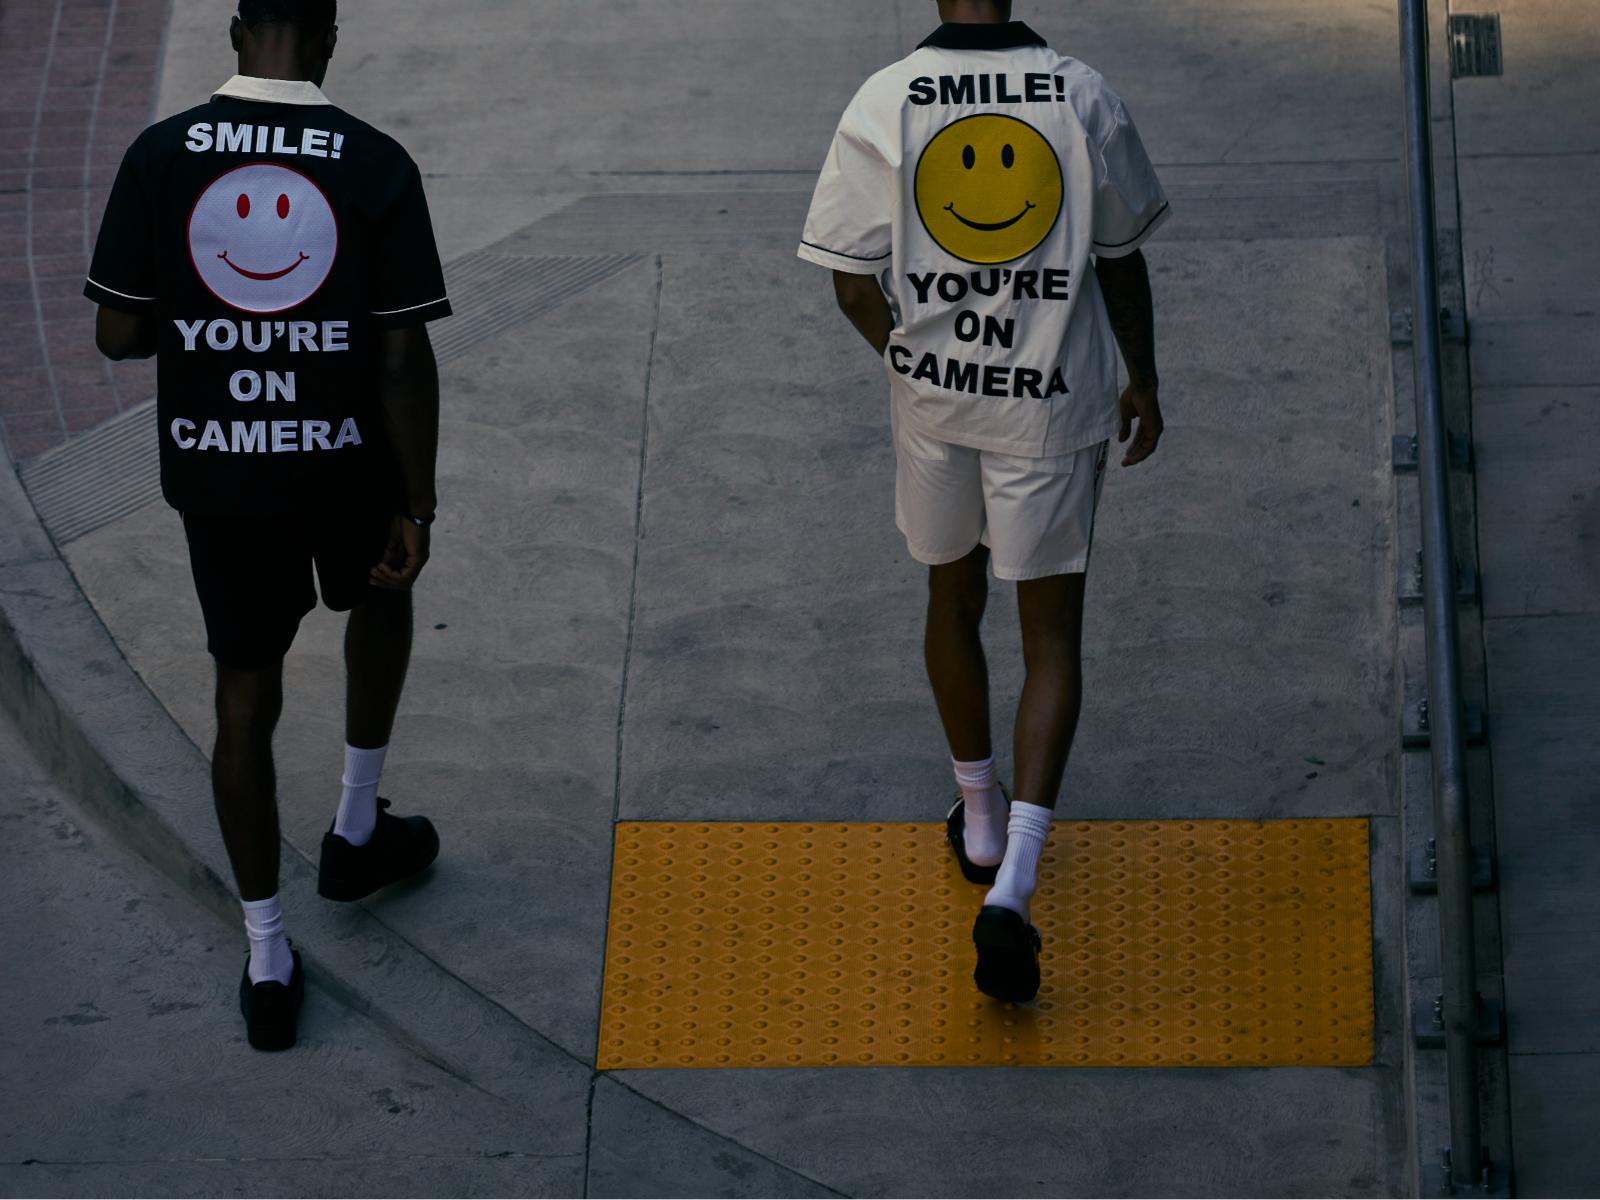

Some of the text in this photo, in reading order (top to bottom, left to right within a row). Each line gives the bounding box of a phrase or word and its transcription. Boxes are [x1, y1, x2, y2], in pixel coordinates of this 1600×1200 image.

[908, 72, 1065, 106] SMILE!
[184, 121, 345, 160] SMILE!
[906, 268, 1070, 304] YOU'RE
[173, 318, 349, 353] YOU'RE
[954, 309, 1015, 349] ON
[228, 369, 296, 402] ON
[889, 344, 1070, 400] CAMERA
[170, 417, 363, 453] CAMERA
